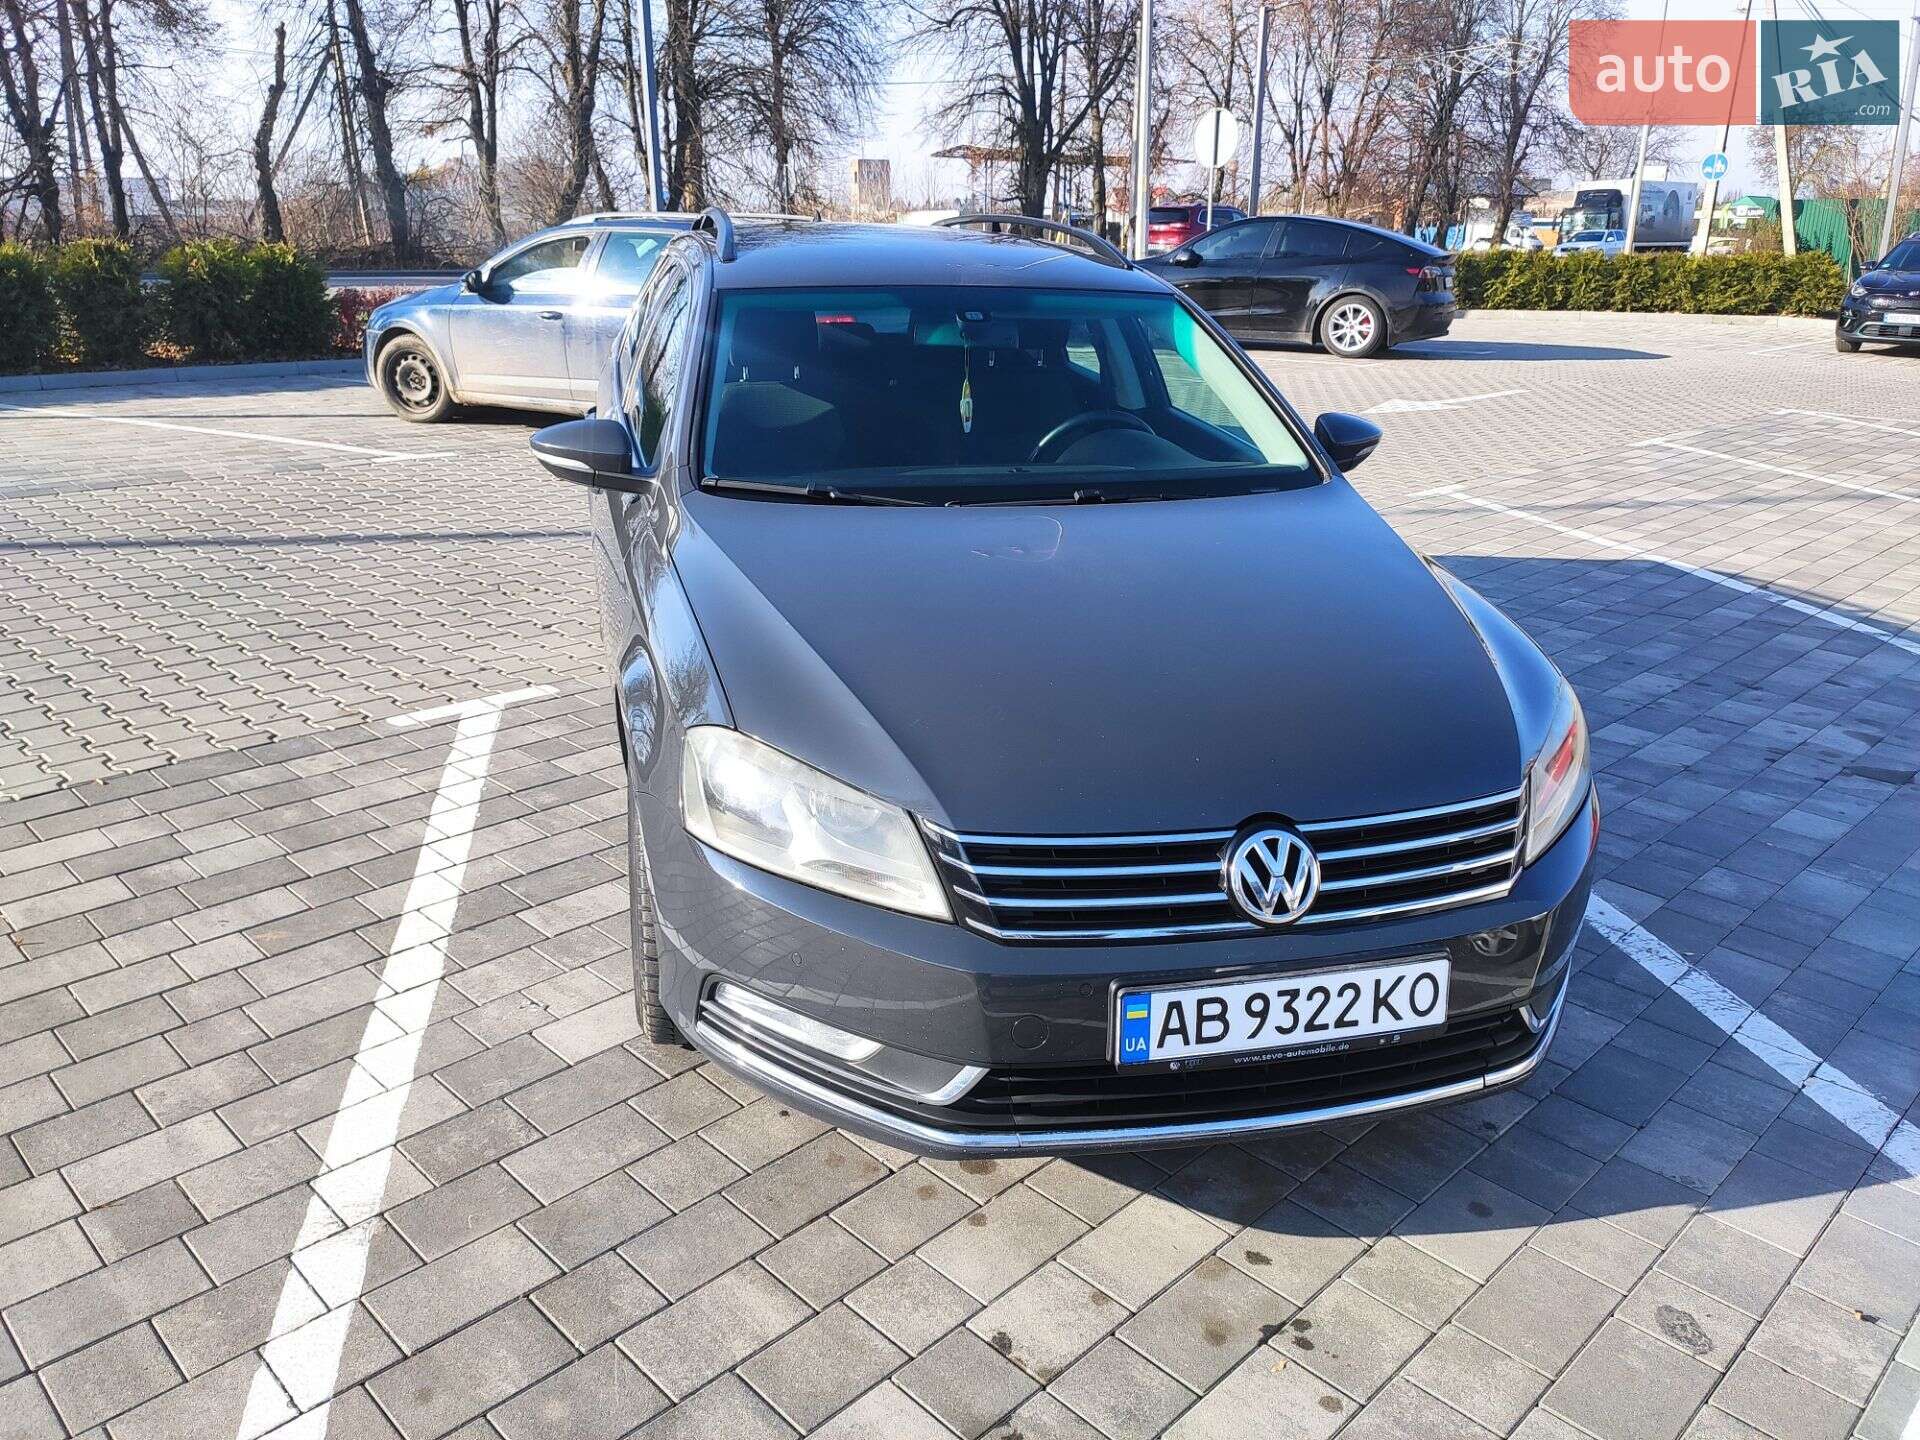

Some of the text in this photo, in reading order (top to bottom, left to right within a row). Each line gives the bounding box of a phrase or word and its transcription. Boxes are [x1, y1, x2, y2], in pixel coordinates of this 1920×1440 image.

[1156, 972, 1440, 1049] AB 9322 KO
[1125, 1036, 1147, 1052] UA
